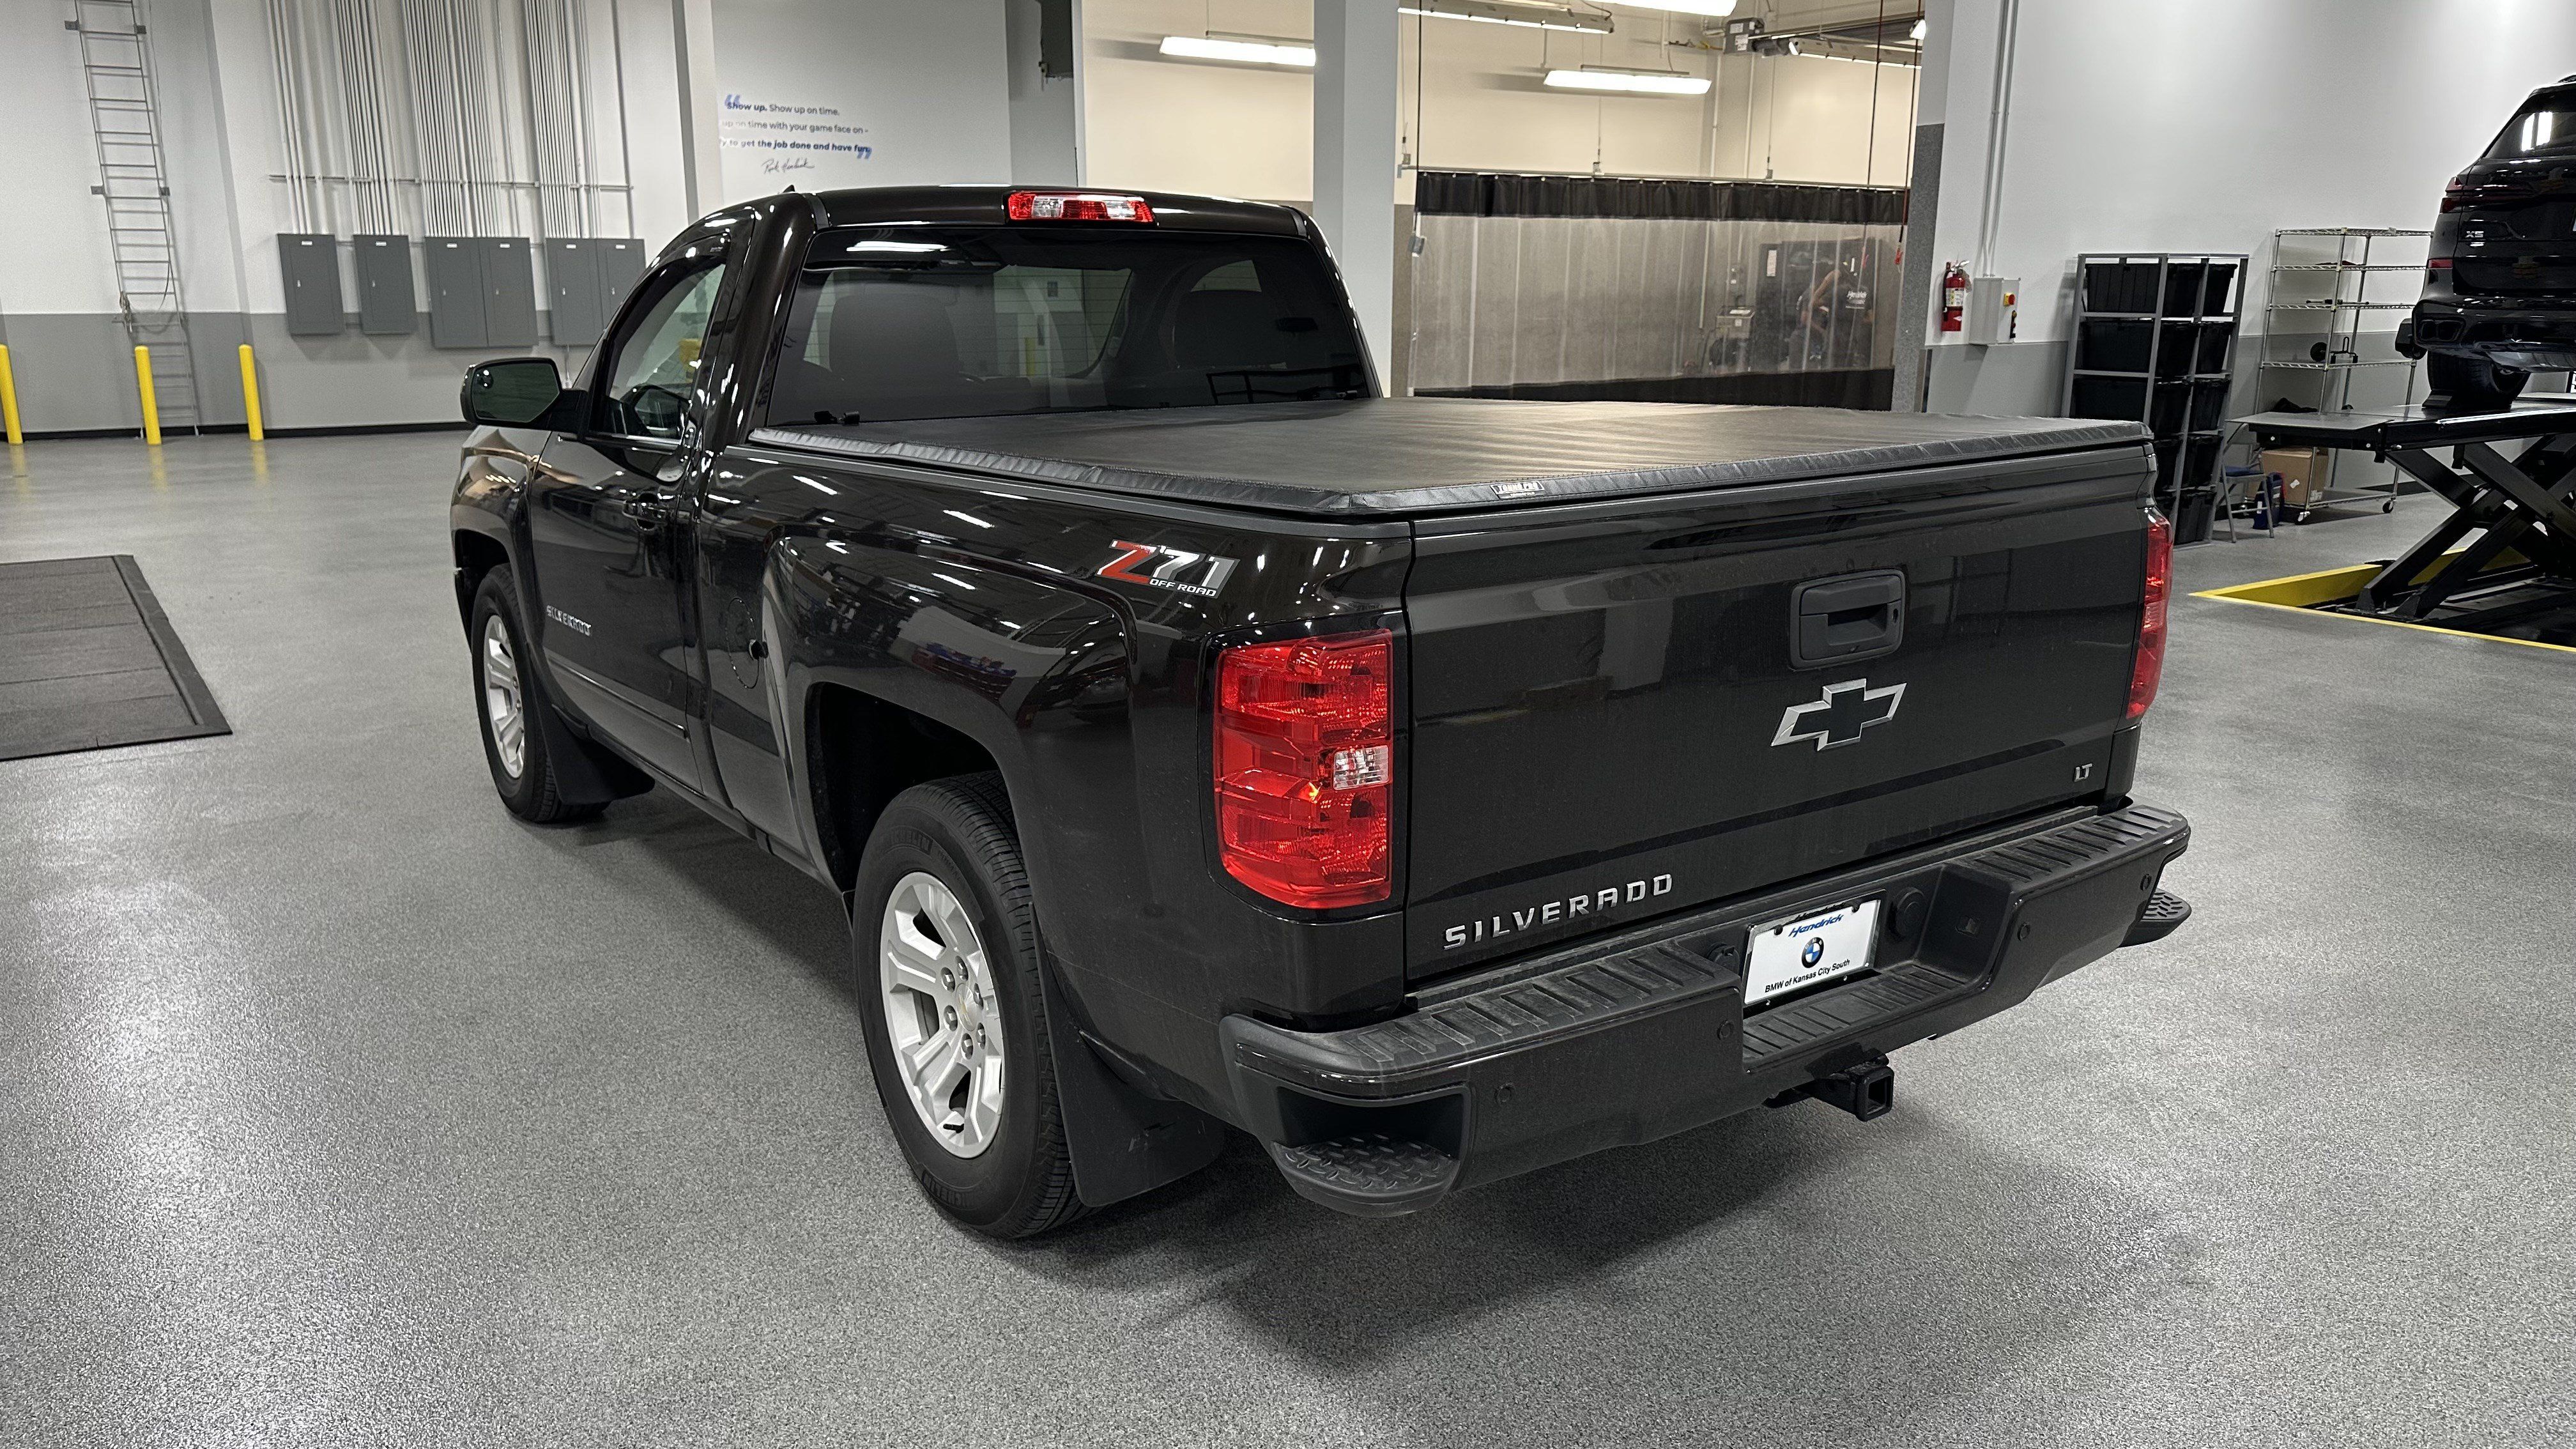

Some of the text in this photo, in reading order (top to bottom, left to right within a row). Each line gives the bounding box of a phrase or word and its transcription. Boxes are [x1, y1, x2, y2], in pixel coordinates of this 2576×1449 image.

[769, 103, 792, 112] Show
[793, 107, 805, 115] up
[748, 120, 767, 129] time
[769, 121, 788, 130] with
[789, 124, 807, 132] your
[809, 125, 832, 133] game
[834, 124, 851, 134] face
[773, 140, 788, 150] job
[789, 141, 811, 150] done
[813, 142, 830, 151] and
[831, 143, 852, 151] have
[1095, 539, 1239, 590] Z71
[1149, 578, 1216, 597] OFF ROAD
[546, 605, 592, 636] SILVERADO
[2074, 763, 2093, 783] LT
[1443, 873, 1673, 951] SILVERADO
[1788, 914, 1844, 937] Hendrick
[1765, 958, 1850, 993] BMW of Kansas City South
